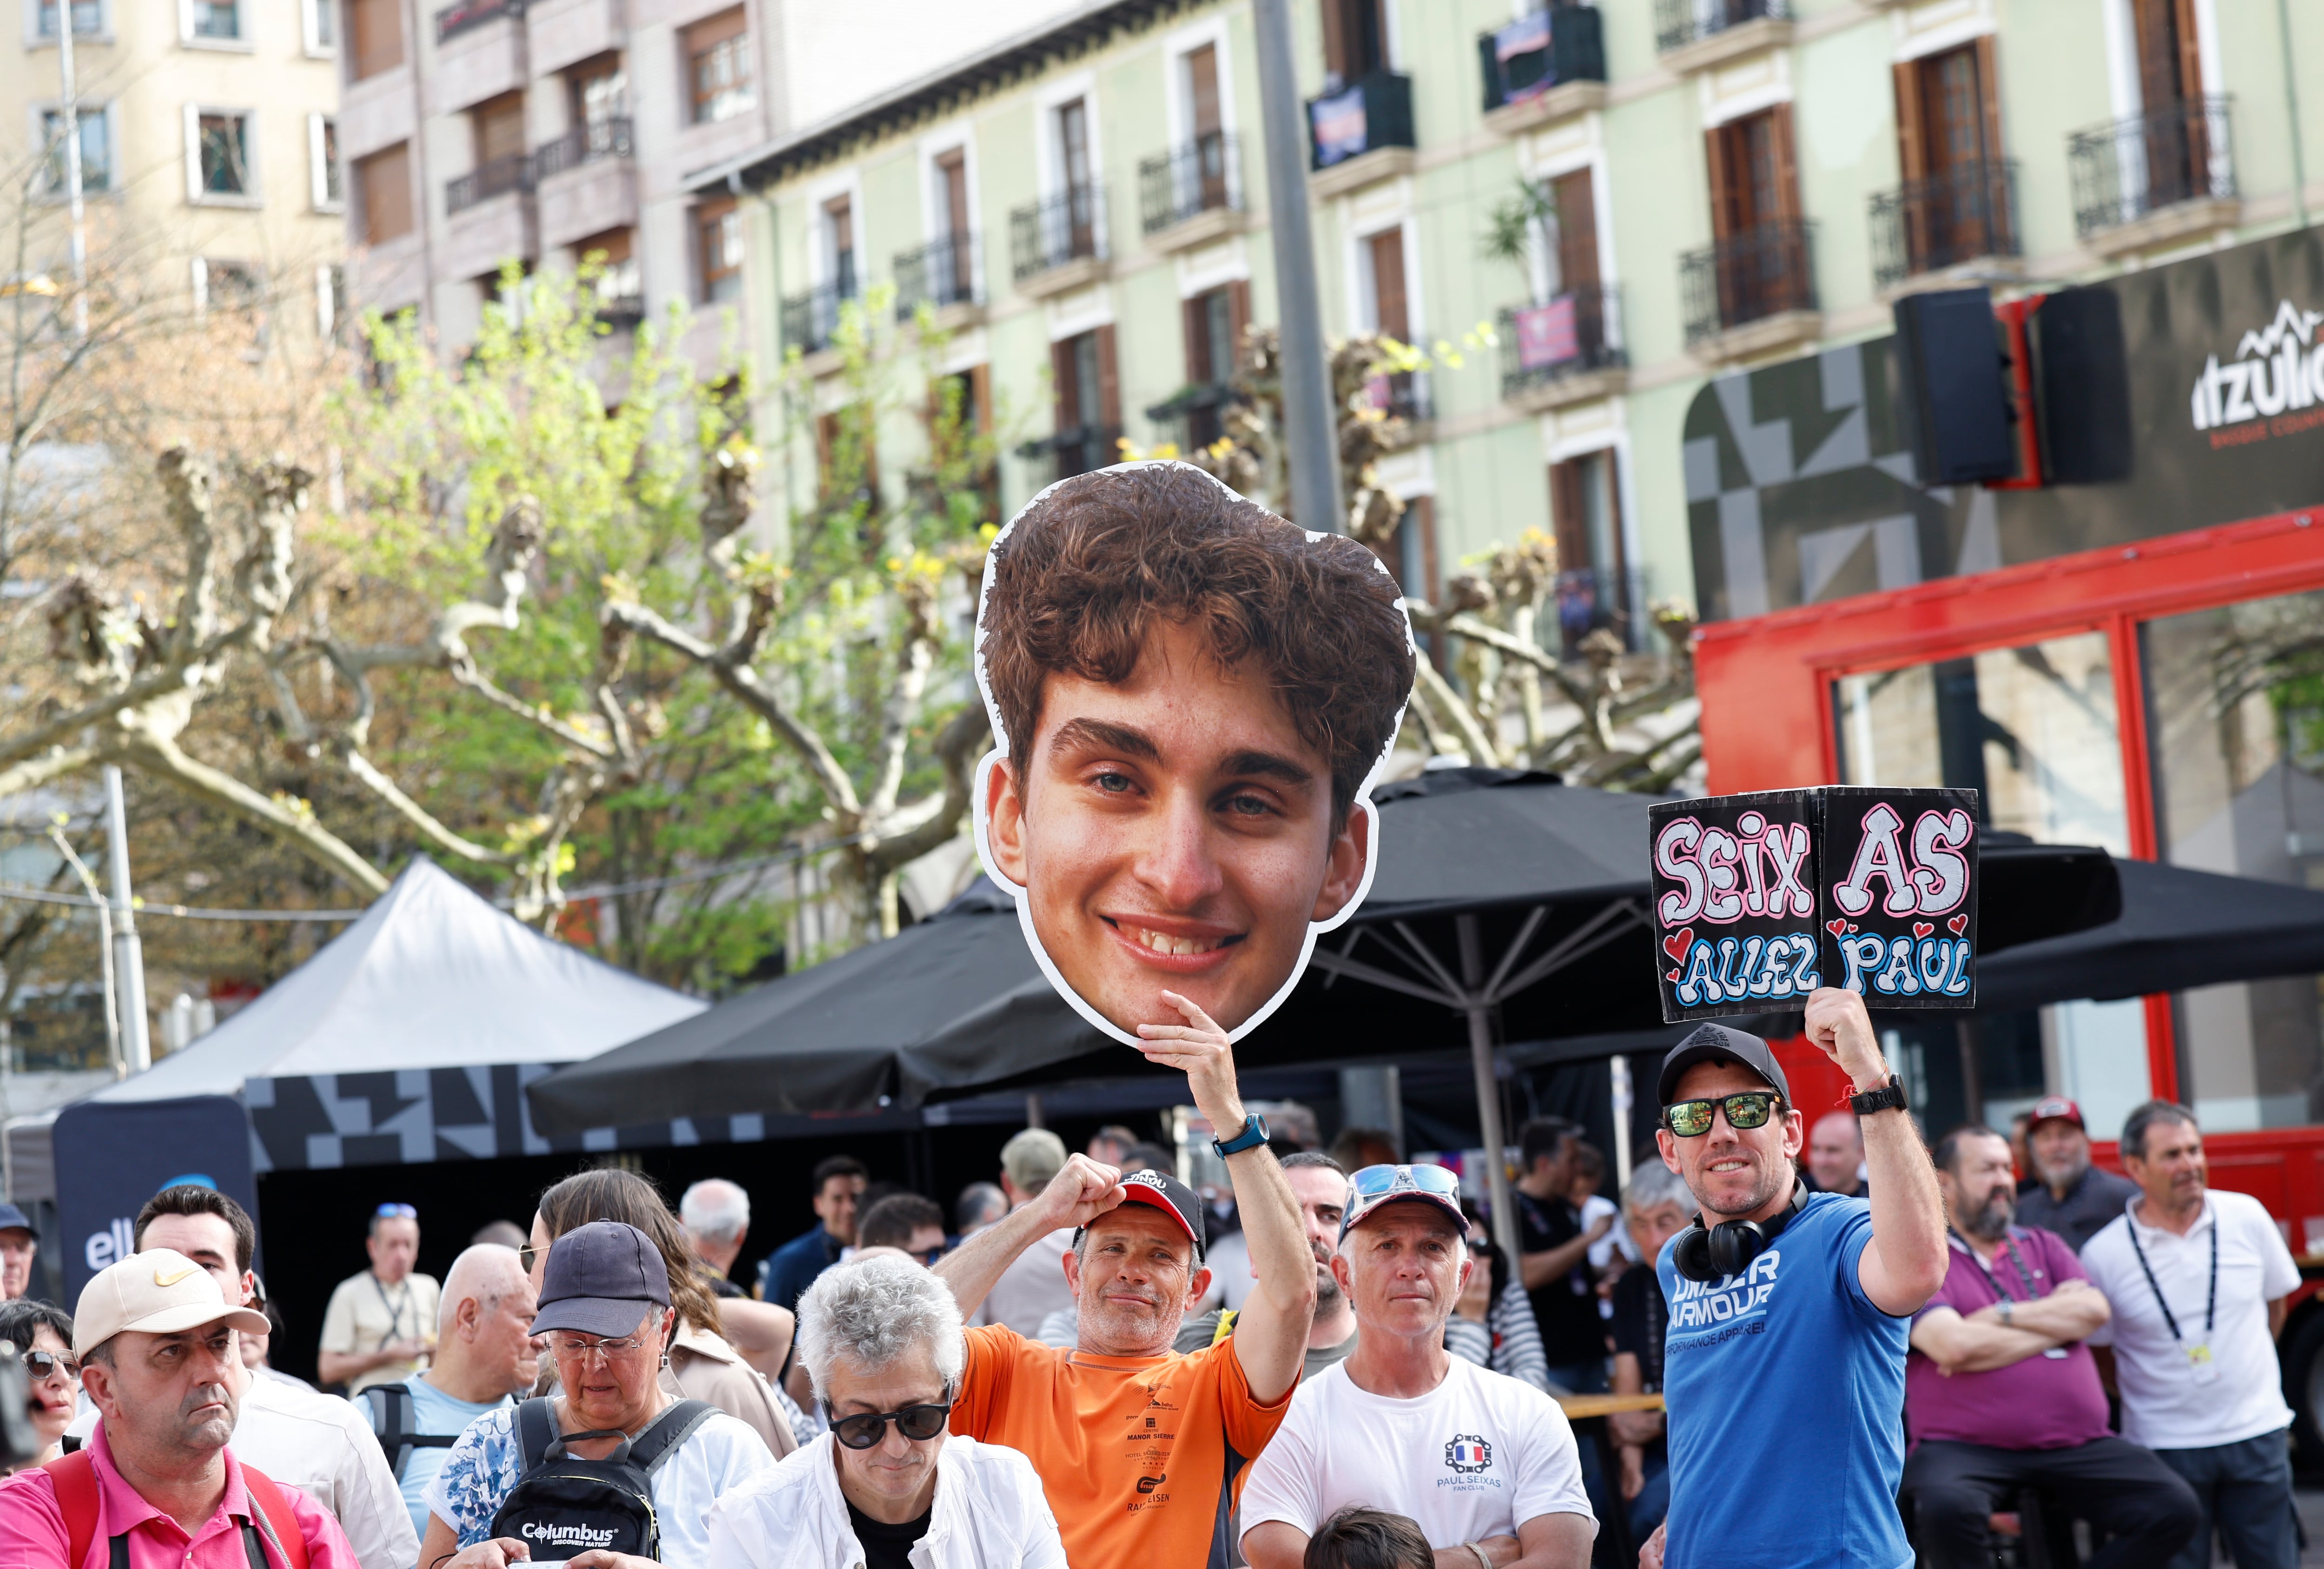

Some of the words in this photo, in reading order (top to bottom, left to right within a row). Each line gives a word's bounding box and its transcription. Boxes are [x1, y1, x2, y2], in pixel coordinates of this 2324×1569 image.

[1833, 802, 1973, 918] AS
[1676, 932, 1821, 1007] ALLEZ
[1837, 932, 1971, 997] PAUL
[1669, 1283, 1775, 1331] ARMOUR
[1718, 1321, 1766, 1344] APPAREL
[1437, 1476, 1464, 1488] PAUL
[1467, 1476, 1501, 1488] SEIXAS
[522, 1523, 613, 1542] Columbus
